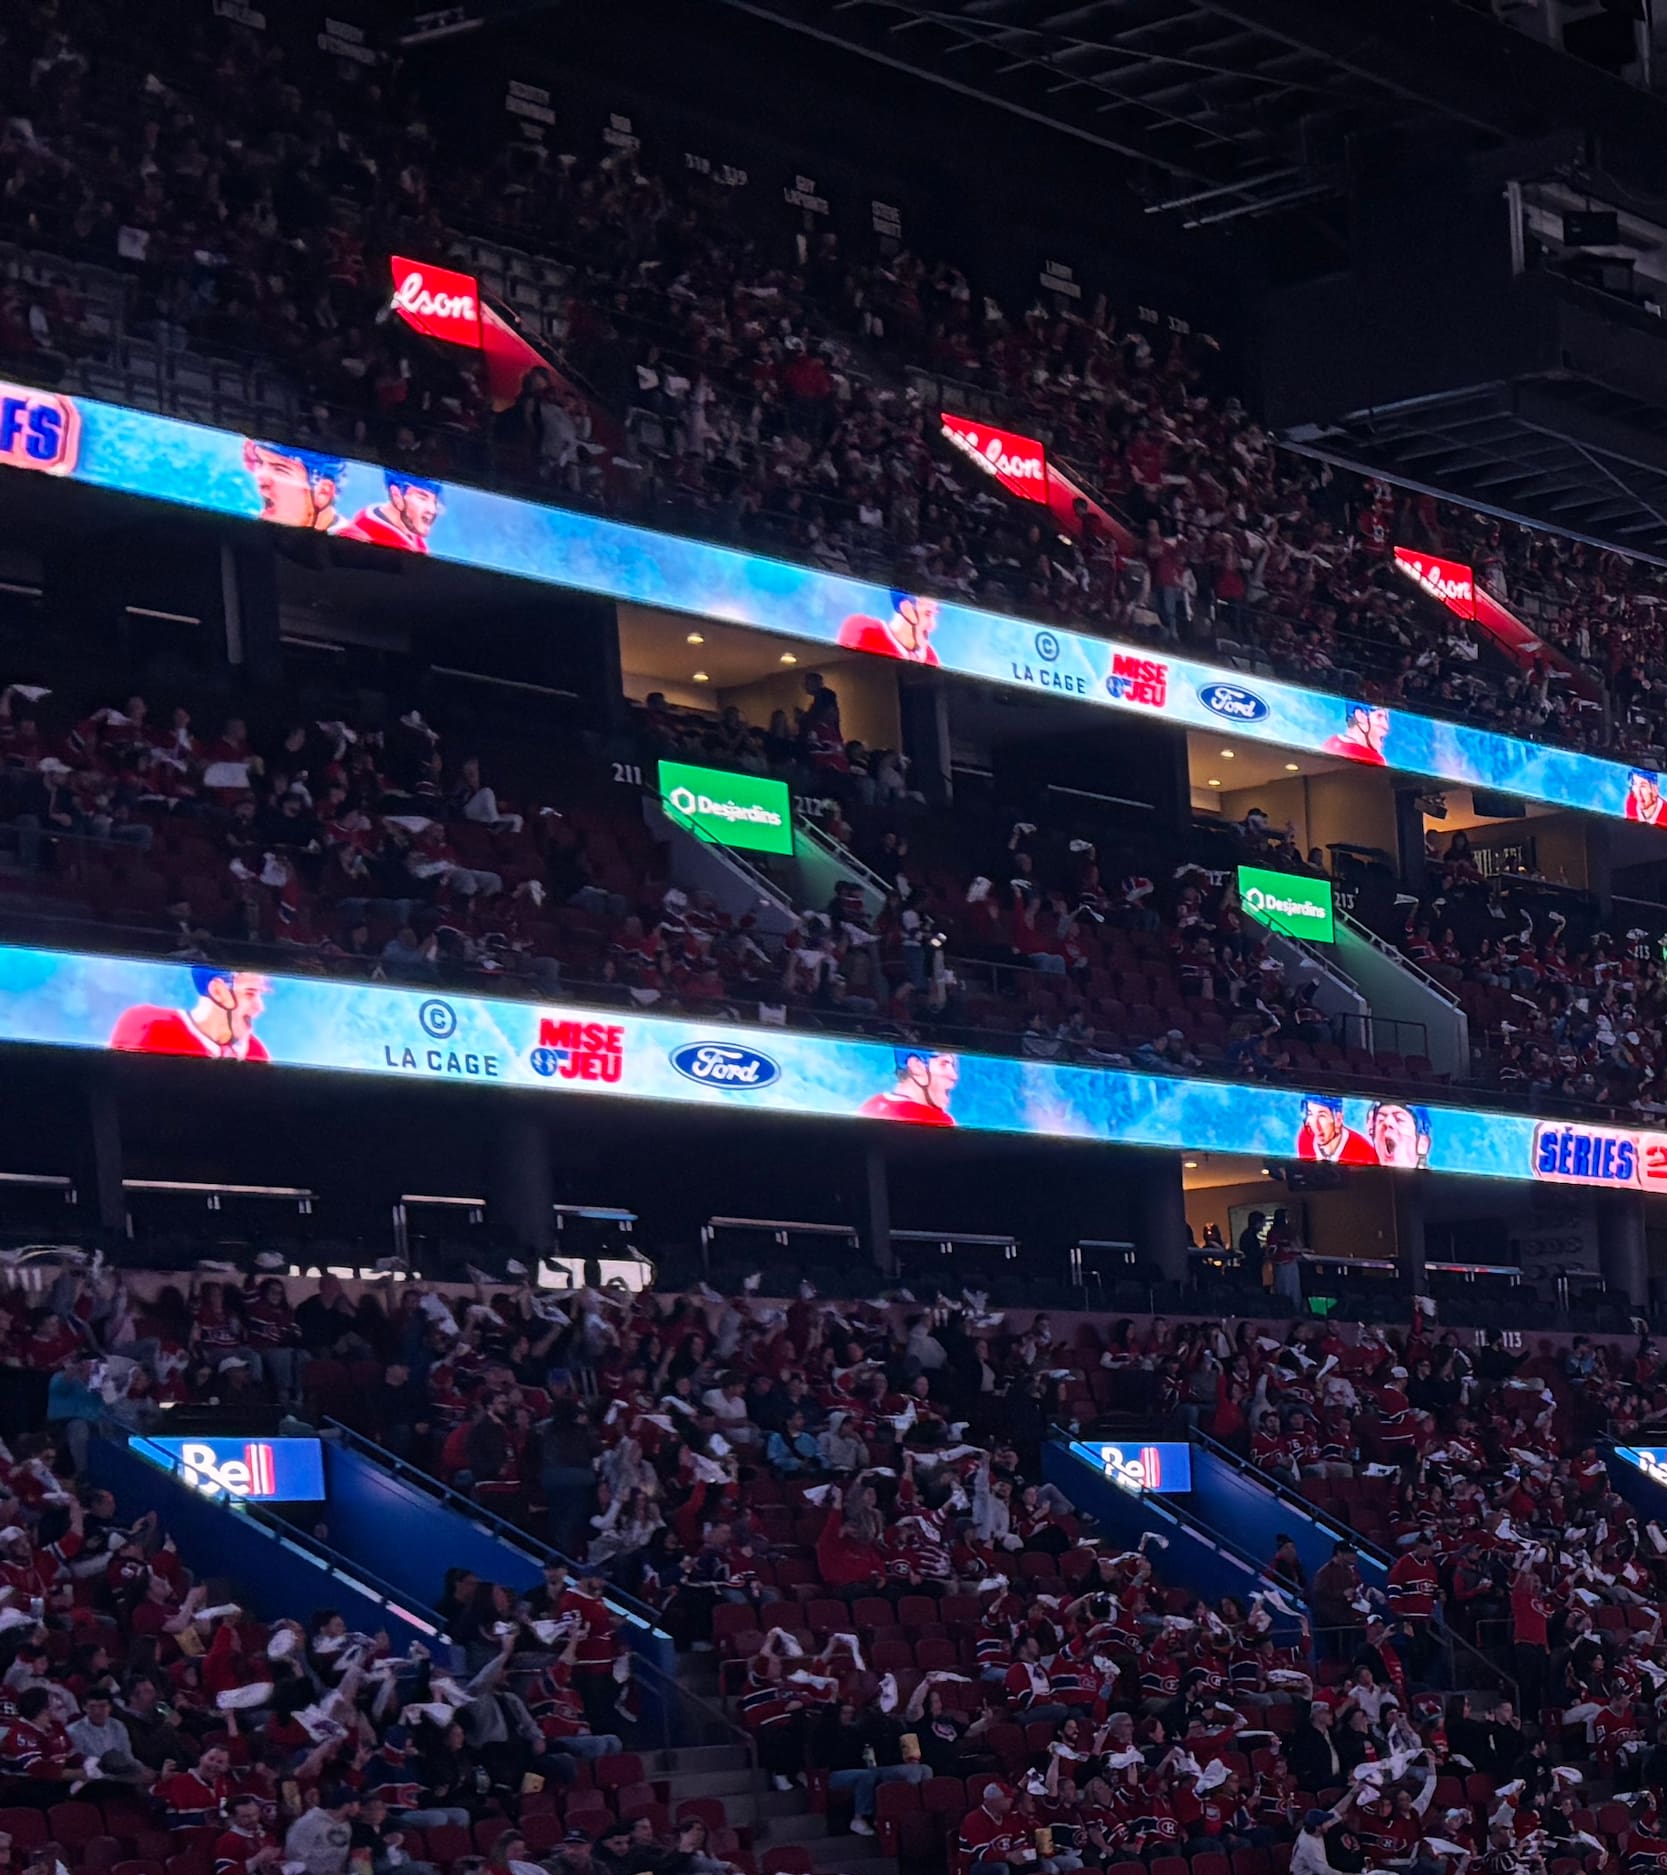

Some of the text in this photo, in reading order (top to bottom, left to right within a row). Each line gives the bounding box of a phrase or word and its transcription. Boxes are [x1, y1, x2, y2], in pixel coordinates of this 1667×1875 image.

[1012, 662, 1087, 695] LA CAGE
[1112, 652, 1169, 686] MISE
[1123, 681, 1168, 709] JEU
[1211, 686, 1259, 720] Ford
[613, 763, 642, 786] 211
[697, 796, 783, 829] Desjardins
[1265, 893, 1326, 919] Desjardins
[538, 1018, 624, 1056] MISE
[384, 1044, 499, 1078] LA CAGE
[558, 1049, 623, 1084] JEU
[691, 1045, 760, 1083] Ford
[1538, 1129, 1634, 1182] SÉRIES
[181, 1444, 274, 1496] Bell
[1101, 1446, 1162, 1489] Bell
